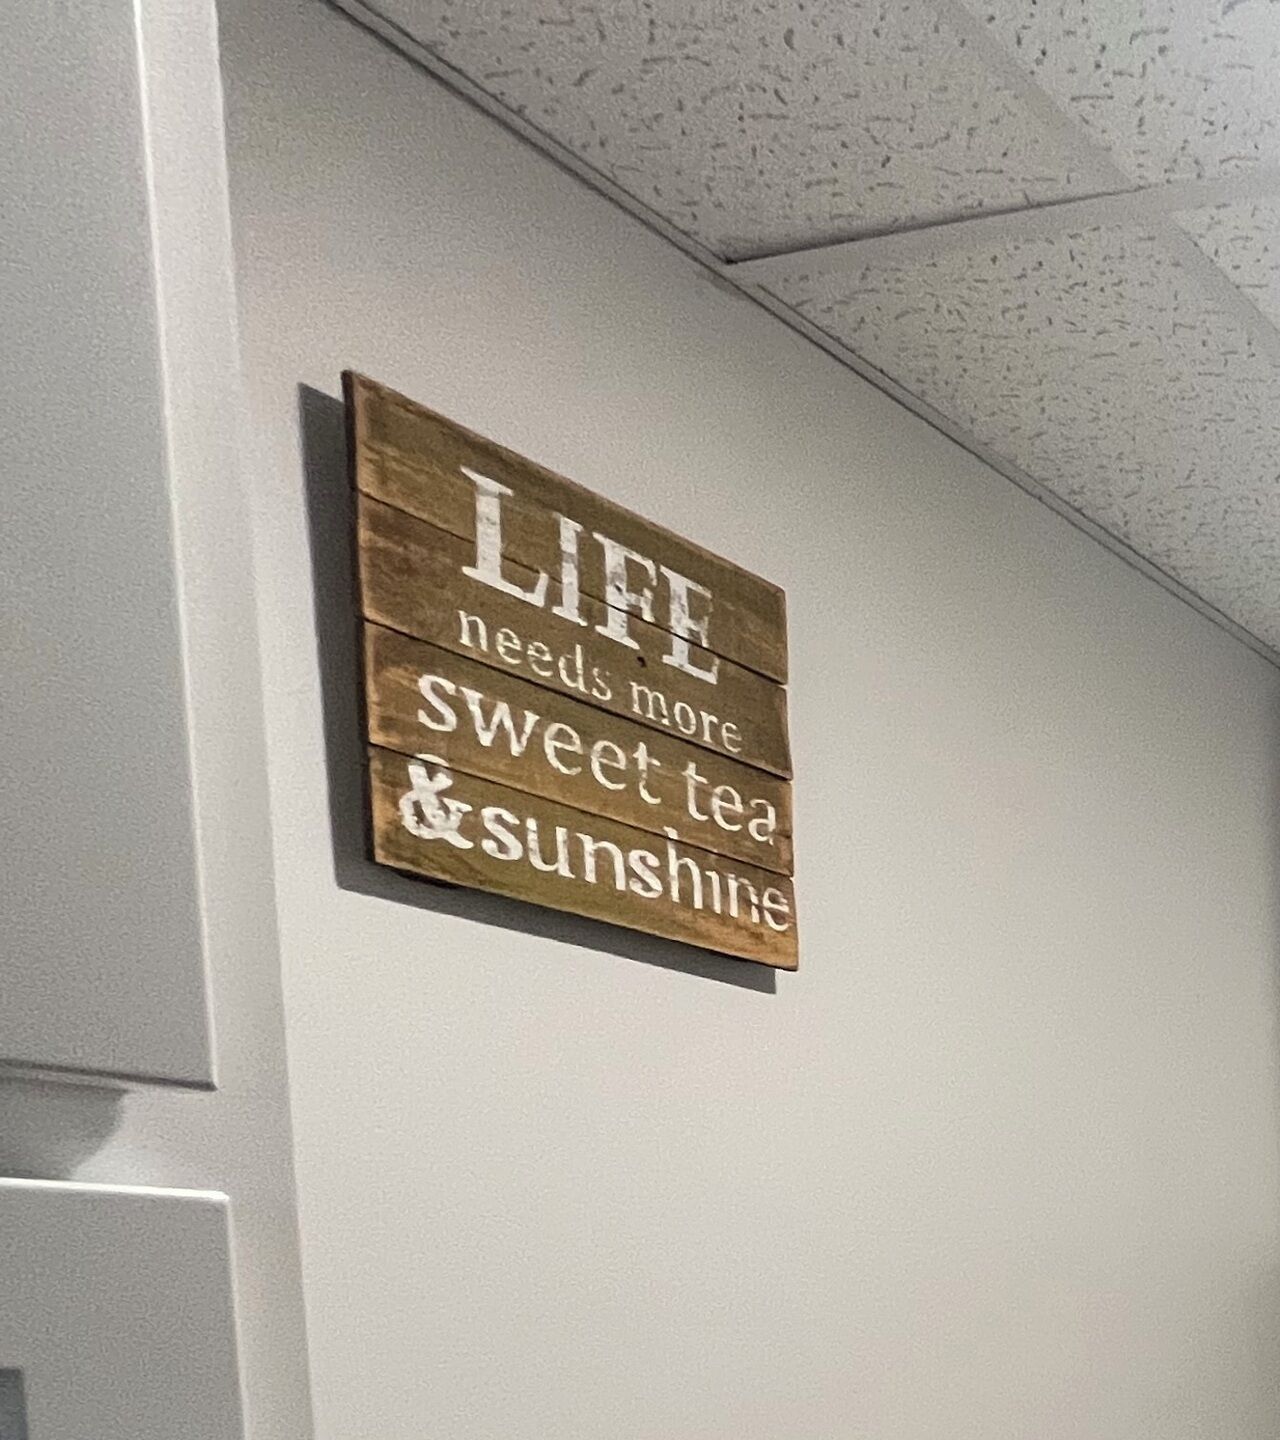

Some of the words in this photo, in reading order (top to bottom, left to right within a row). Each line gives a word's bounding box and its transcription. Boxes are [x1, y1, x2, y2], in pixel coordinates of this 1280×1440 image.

[460, 465, 718, 685] LIFE
[416, 673, 662, 805] sweet
[683, 761, 777, 846] tea
[458, 608, 612, 702] needs
[630, 679, 743, 754] more
